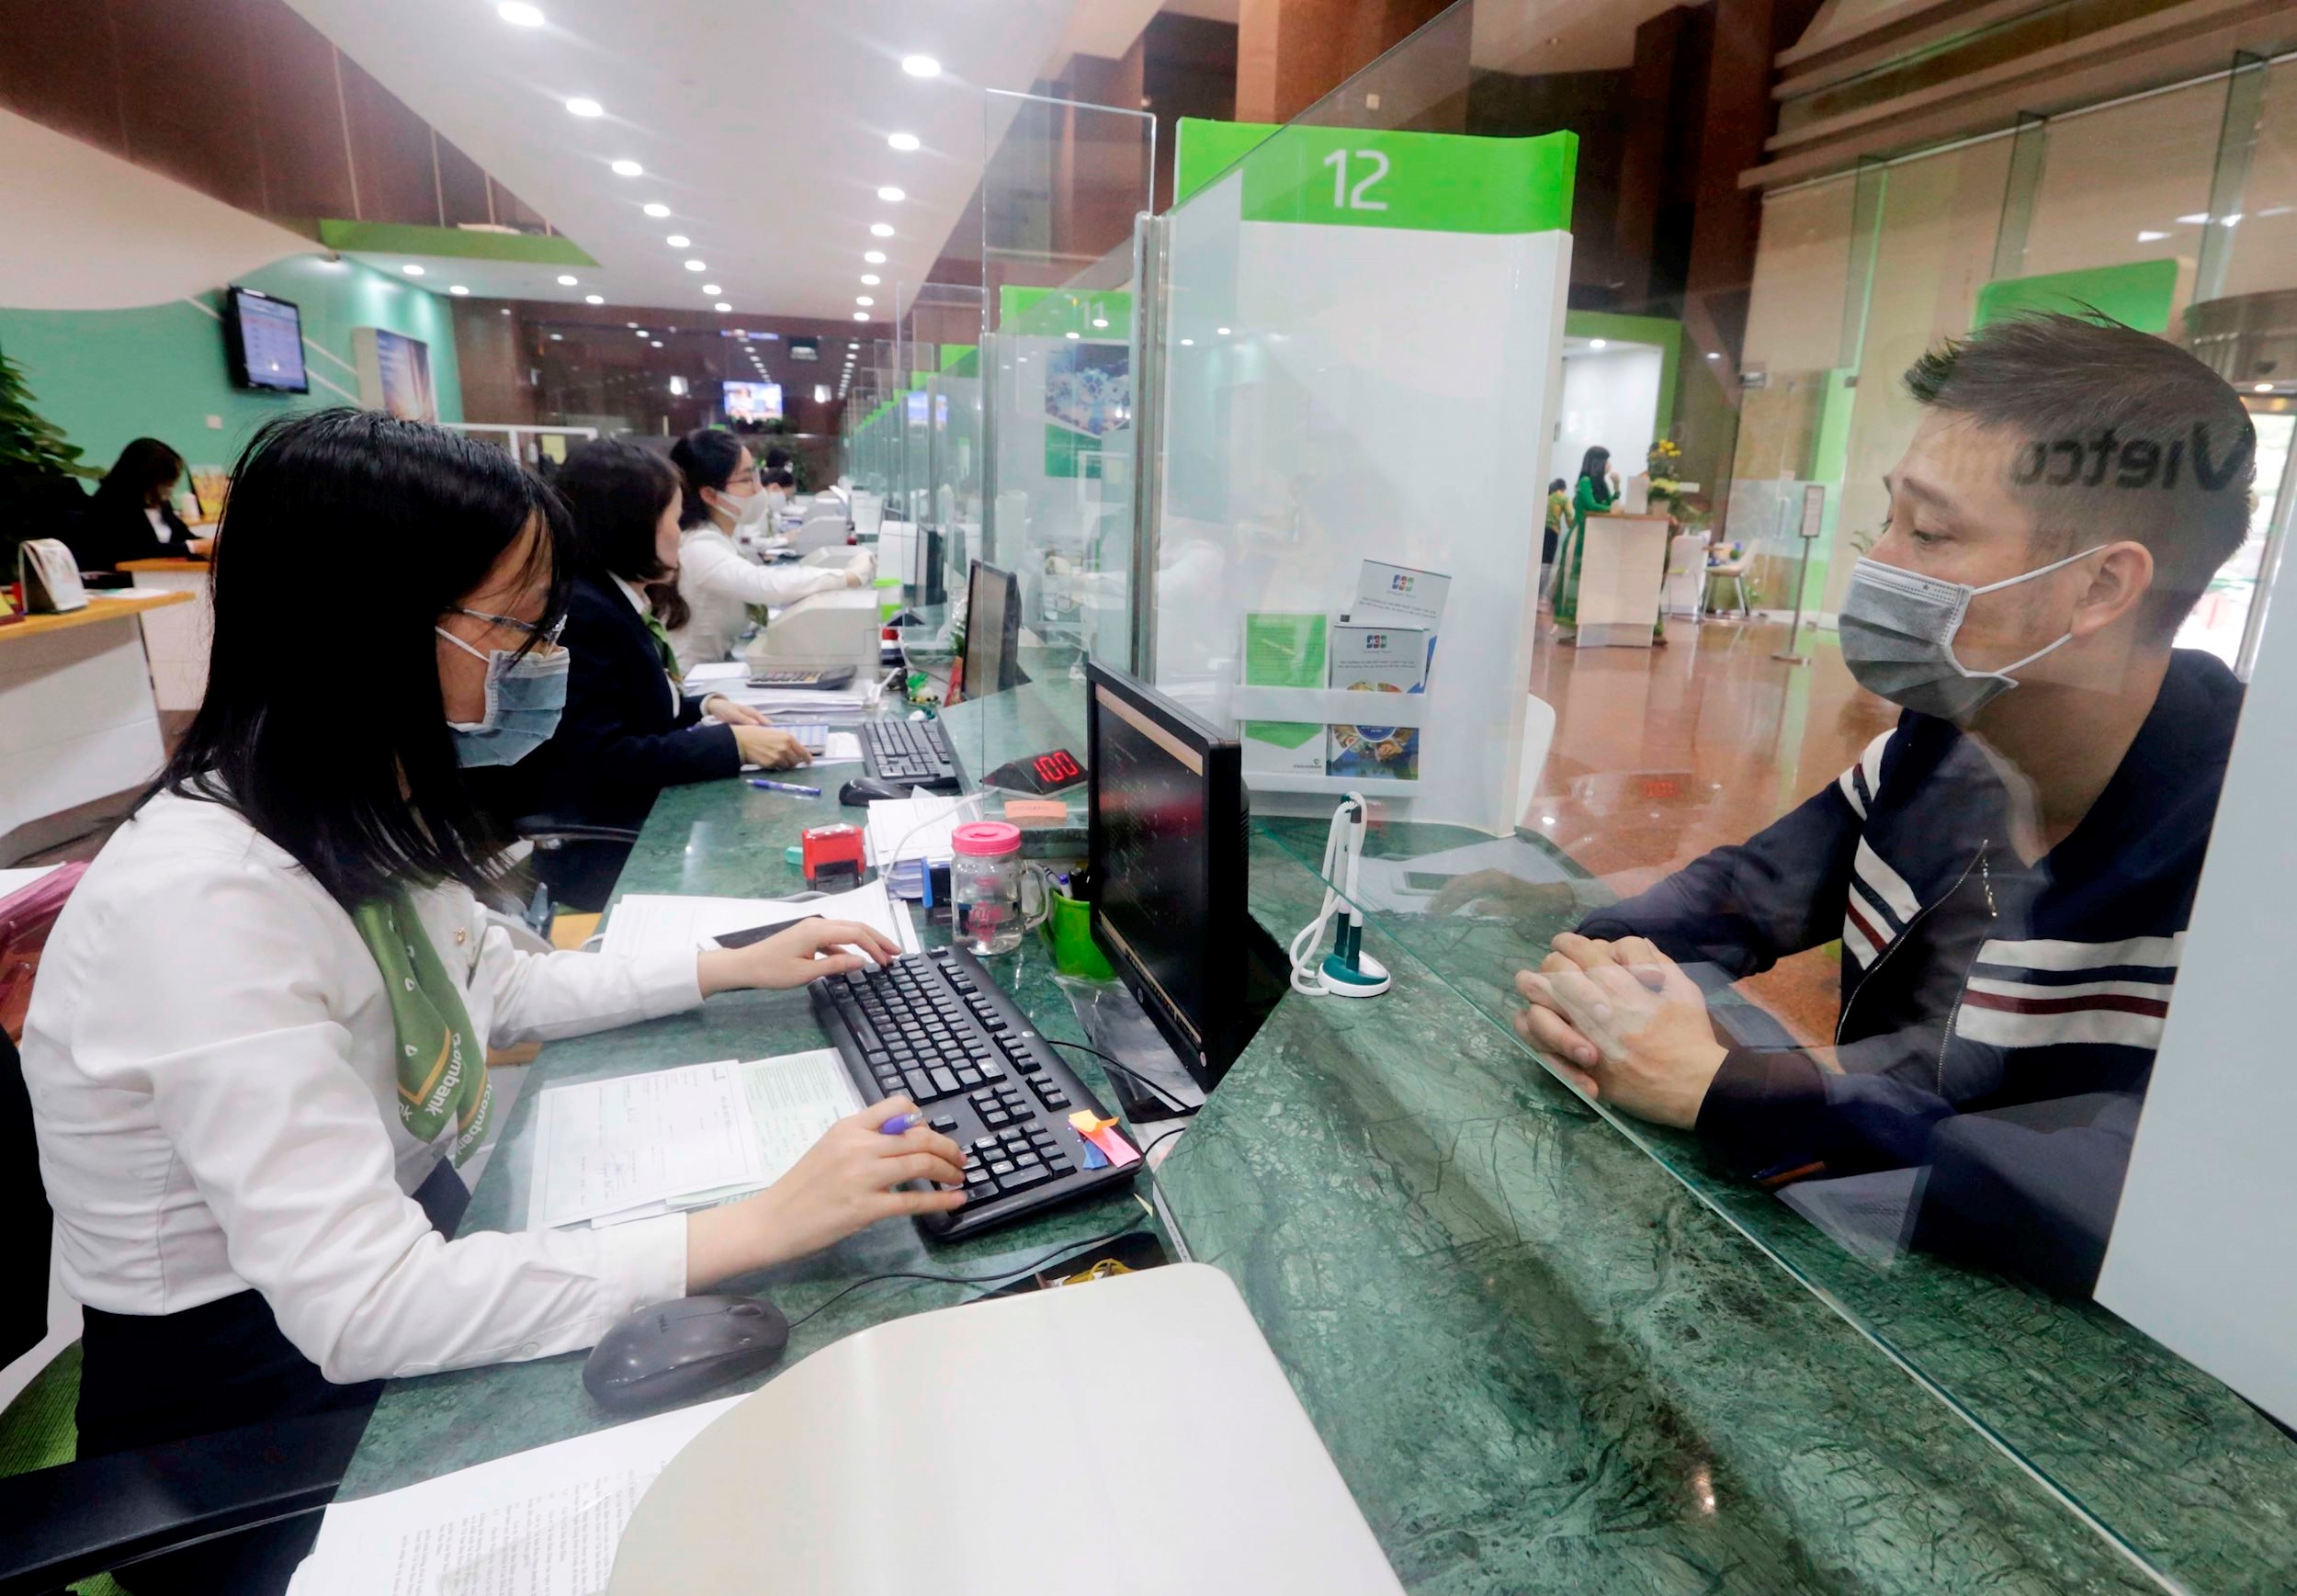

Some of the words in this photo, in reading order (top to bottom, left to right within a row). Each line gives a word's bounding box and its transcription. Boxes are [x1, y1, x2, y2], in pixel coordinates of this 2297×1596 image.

[1323, 149, 1389, 210] 12
[1080, 300, 1105, 330] 11
[1034, 751, 1080, 783] 100
